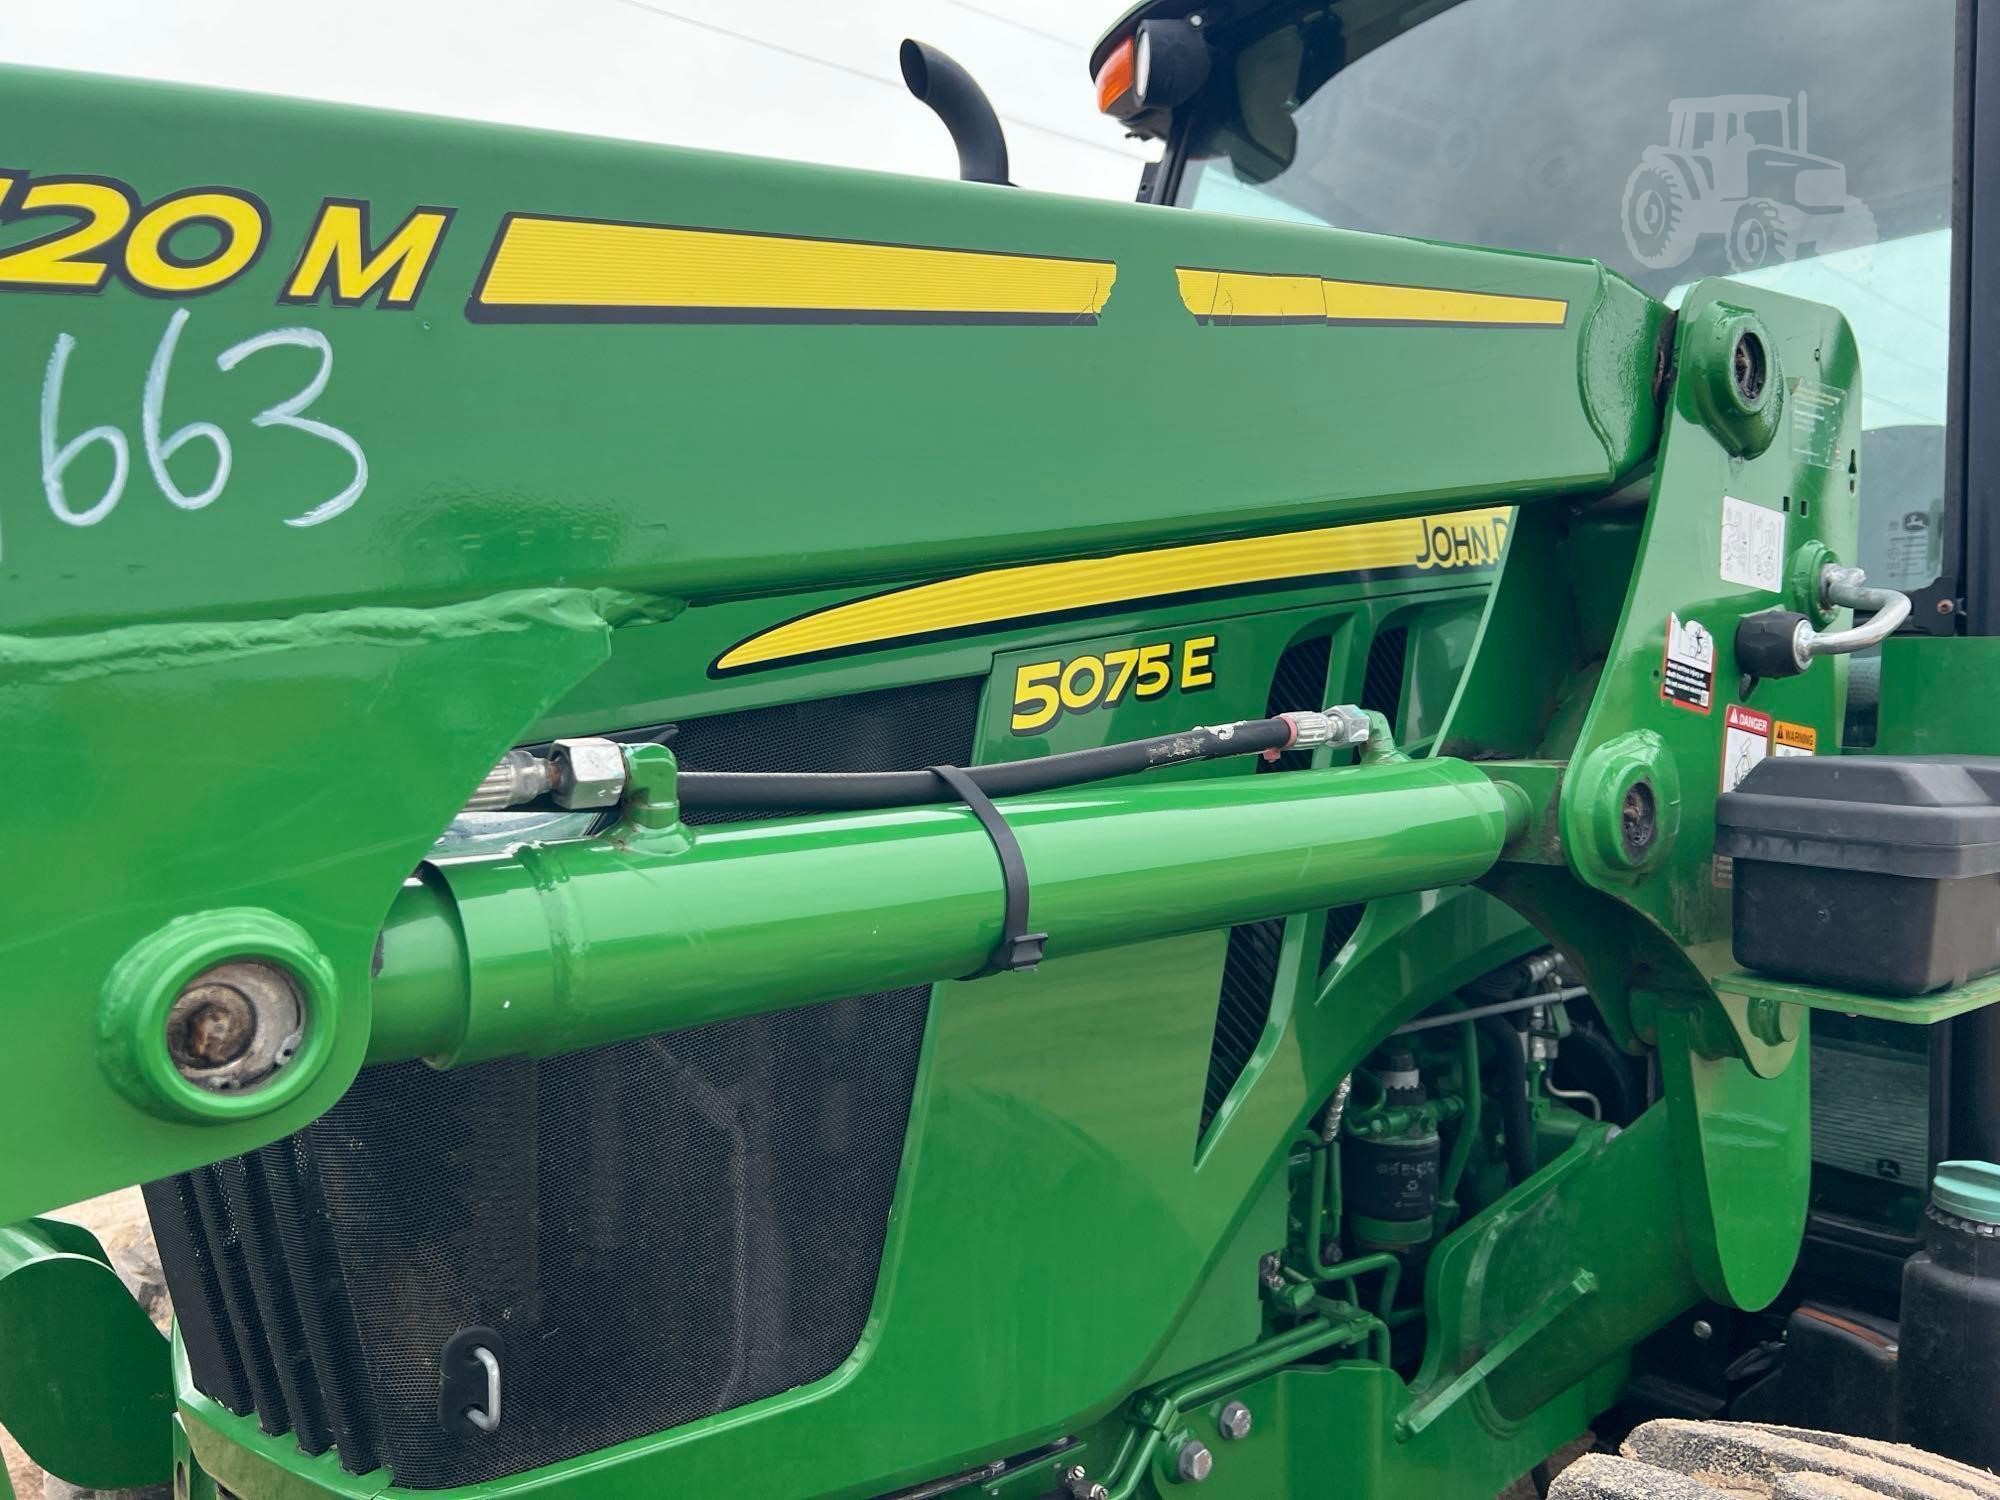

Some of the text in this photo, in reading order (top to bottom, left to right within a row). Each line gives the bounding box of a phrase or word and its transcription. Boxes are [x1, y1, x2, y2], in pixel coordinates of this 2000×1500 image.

[0, 170, 453, 307] 20 M
[41, 308, 368, 527] 663
[1416, 518, 1491, 563] JOHN
[1011, 635, 1218, 734] 5075 E
[1739, 713, 1768, 732] DANGER
[1785, 730, 1814, 746] WARNING
